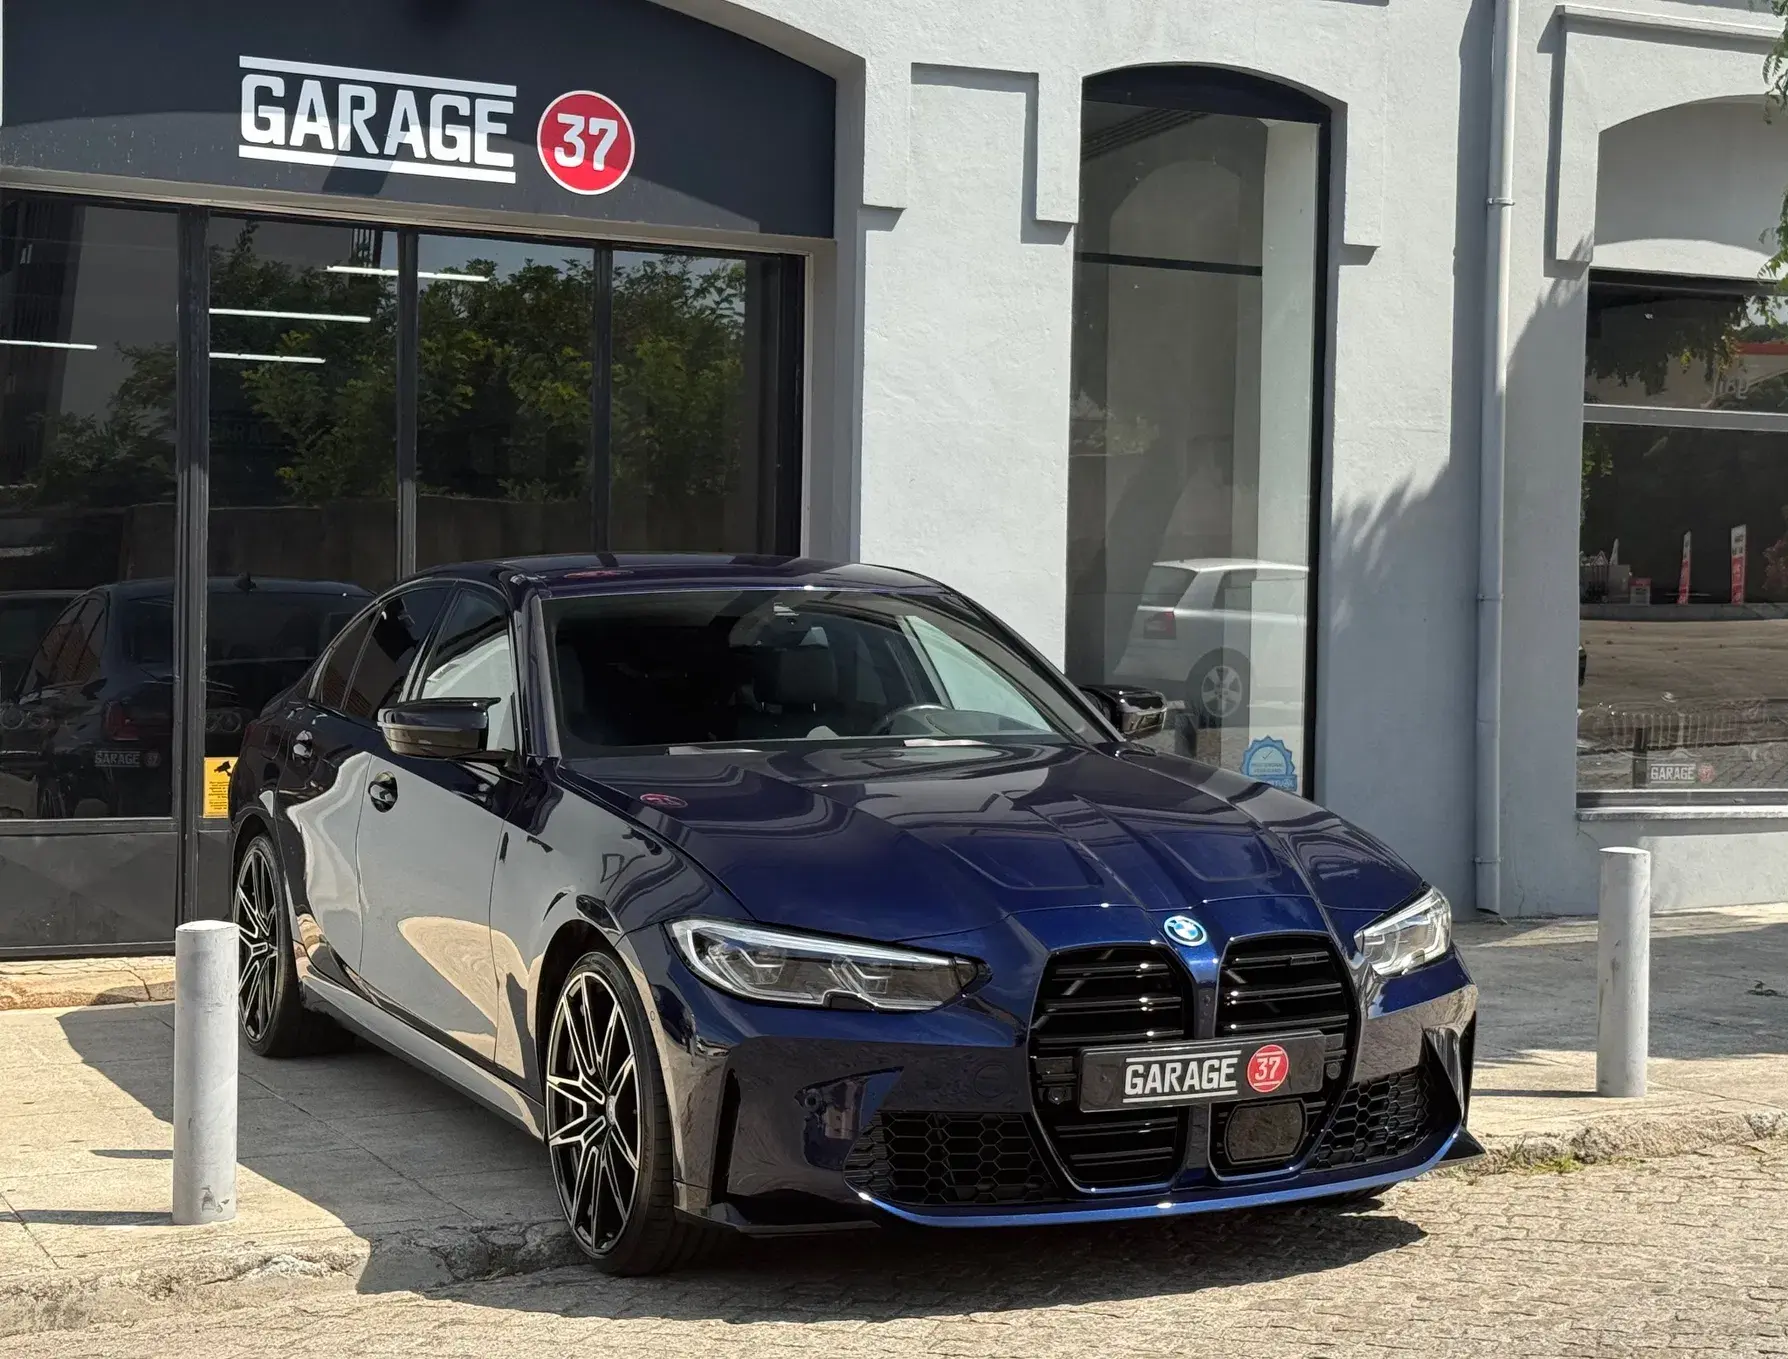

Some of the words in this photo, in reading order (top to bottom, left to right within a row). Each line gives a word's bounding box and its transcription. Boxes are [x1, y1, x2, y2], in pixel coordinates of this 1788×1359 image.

[241, 74, 514, 168] GARAGE
[554, 113, 618, 172] 37
[1651, 766, 1696, 780] GARAGE
[1124, 1057, 1238, 1096] GARAGE
[1254, 1056, 1282, 1081] 37
